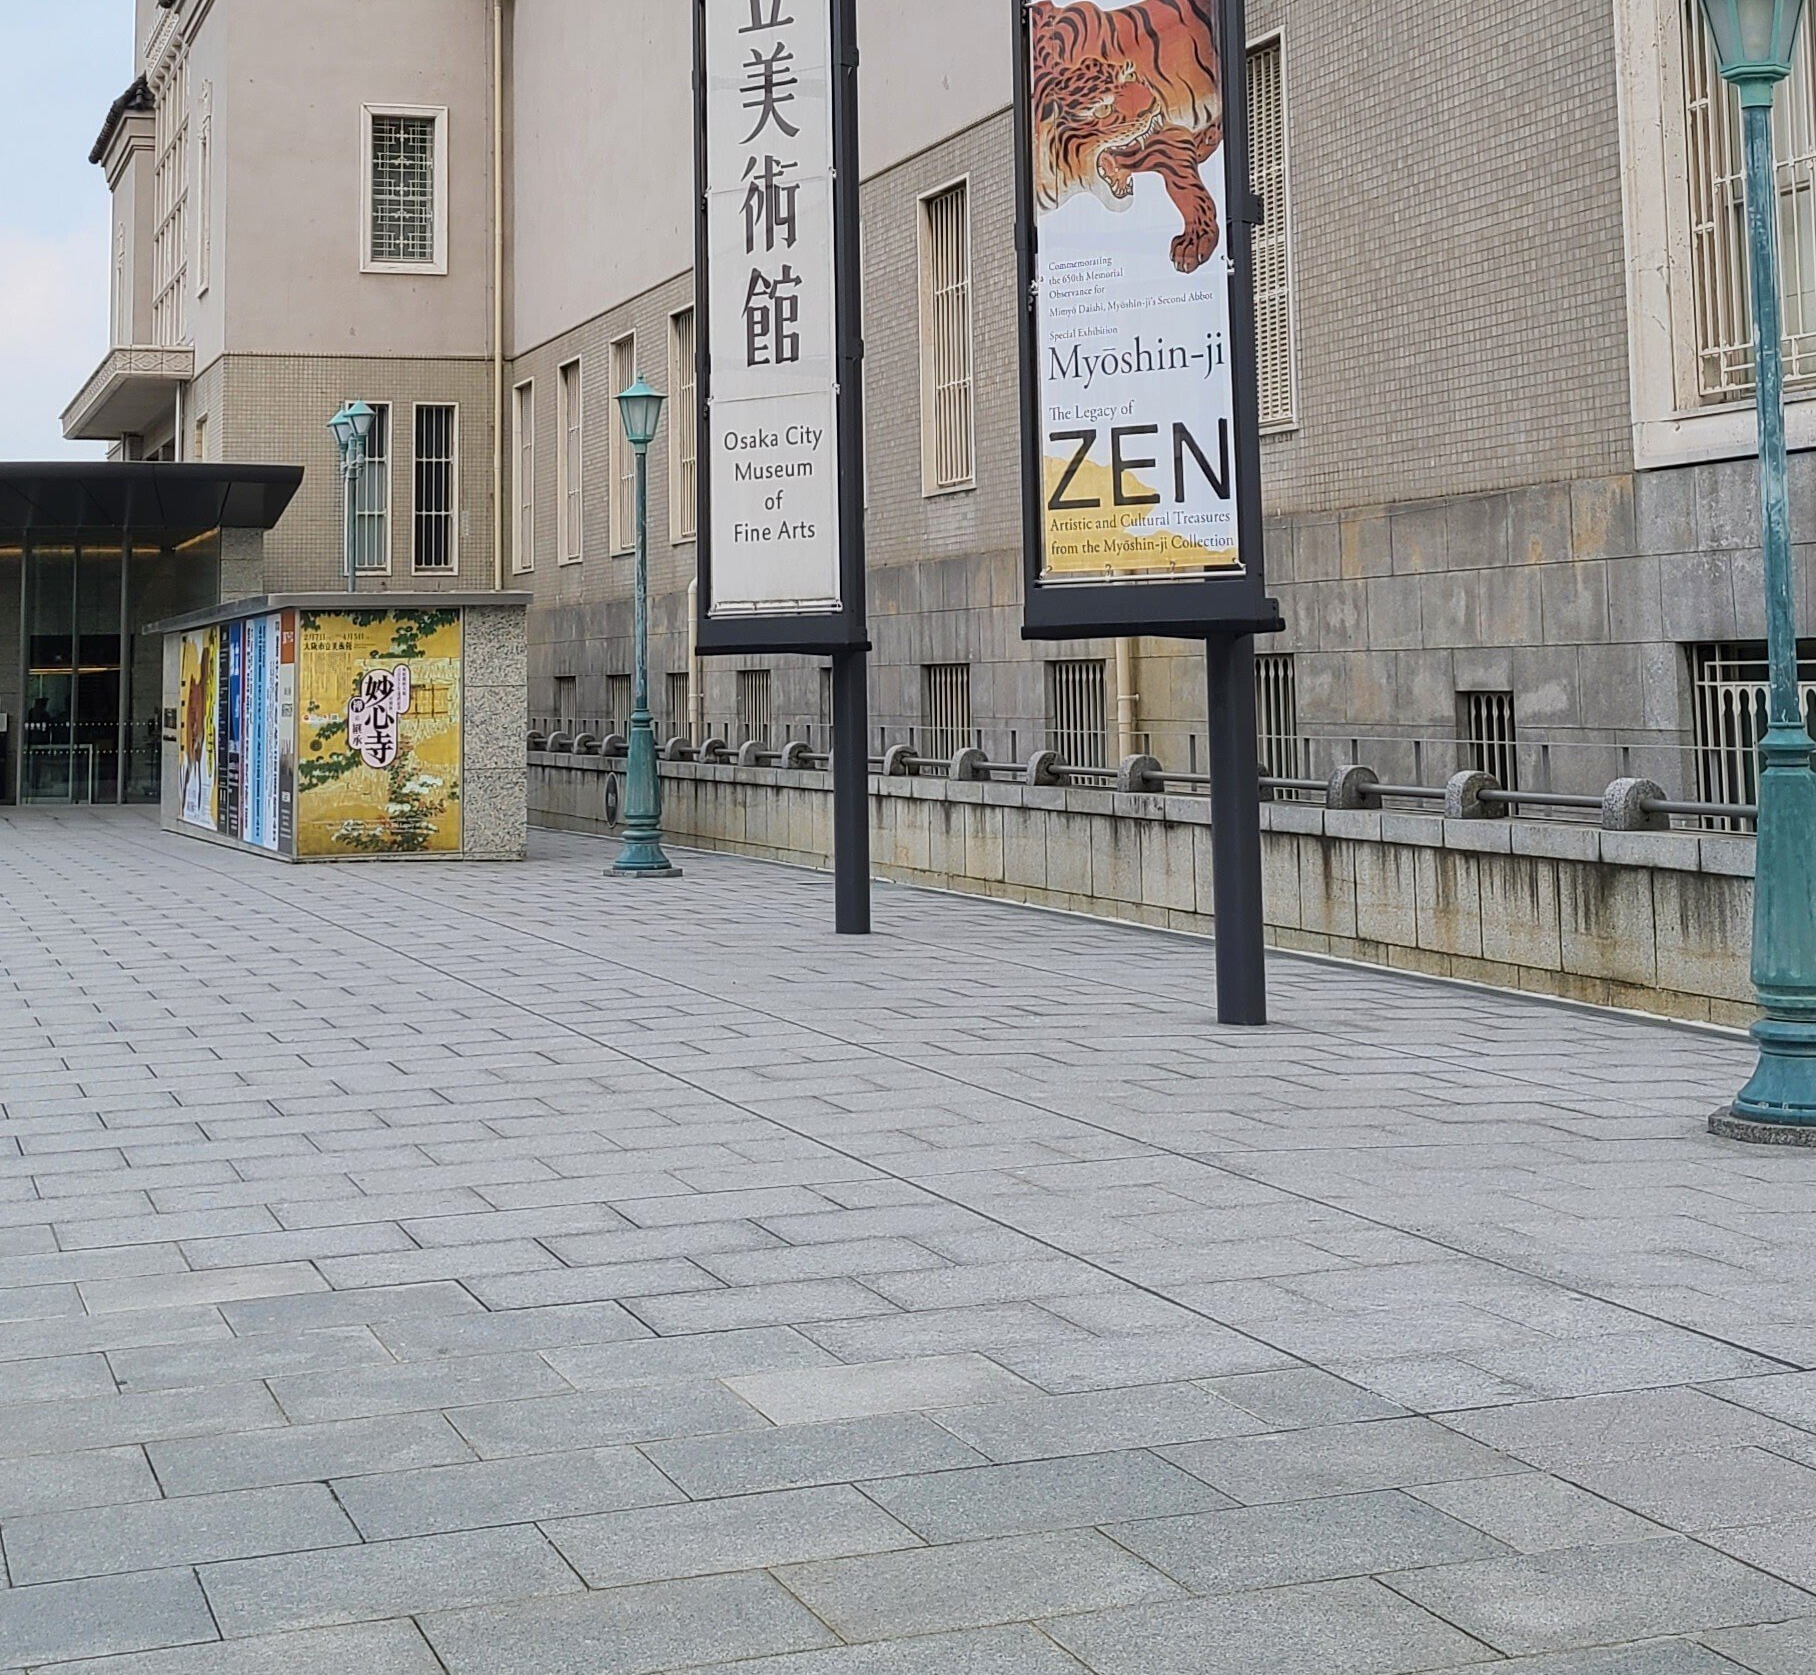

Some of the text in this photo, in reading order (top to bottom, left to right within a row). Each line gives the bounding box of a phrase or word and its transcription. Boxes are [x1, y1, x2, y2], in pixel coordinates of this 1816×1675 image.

[1048, 256, 1113, 271] Commemorating
[1048, 267, 1123, 285] the 650th Memorial
[1048, 284, 1105, 299] Observance for
[1157, 293, 1186, 305] Second
[1188, 290, 1213, 302] Abbot
[1049, 324, 1118, 343] Special Exhibition
[1048, 331, 1225, 389] Myōshin-ji
[1049, 400, 1135, 423] The Legacy of
[724, 425, 823, 451] Osaka City
[735, 461, 813, 481] Museum
[1047, 417, 1231, 511] ZEN
[764, 489, 784, 510] of
[734, 520, 816, 543] Fine Arts
[1050, 511, 1231, 532] Artistic and Cultural Treasures
[1051, 533, 1234, 556] from the Myōshin-ji Collection
[364, 674, 395, 764] 妙心寺
